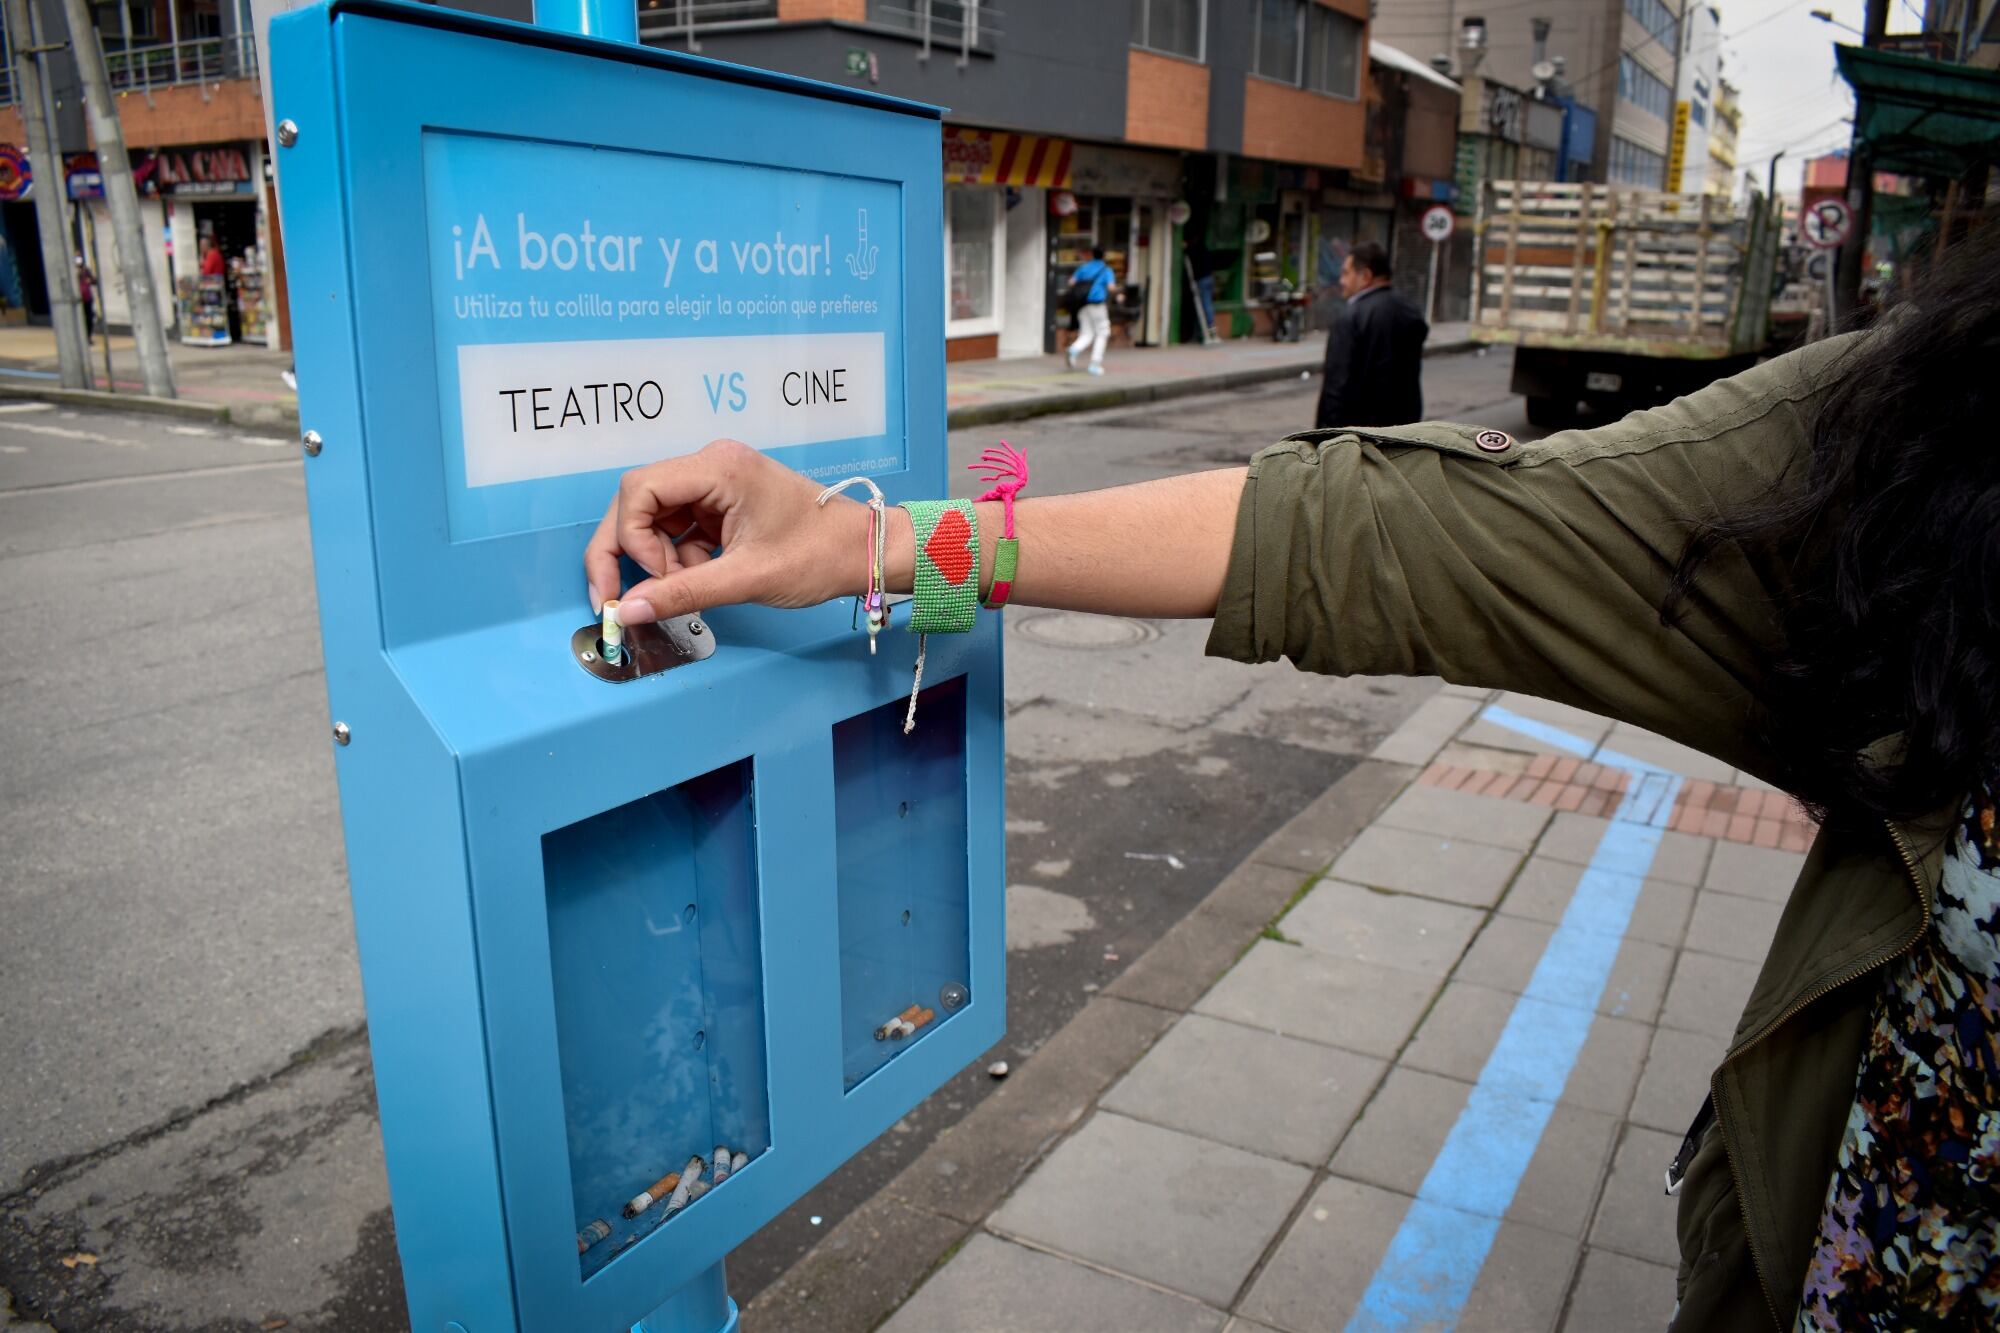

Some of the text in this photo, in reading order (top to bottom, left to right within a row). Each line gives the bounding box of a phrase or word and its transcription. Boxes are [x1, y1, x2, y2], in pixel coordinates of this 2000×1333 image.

[159, 149, 250, 184] LA CAVA
[452, 212, 832, 288] ¡A botar y a votar!
[454, 293, 878, 322] Utiliza tu colilla para elegir la opción que prefieres
[499, 369, 848, 433] TEATRO VS CINE
